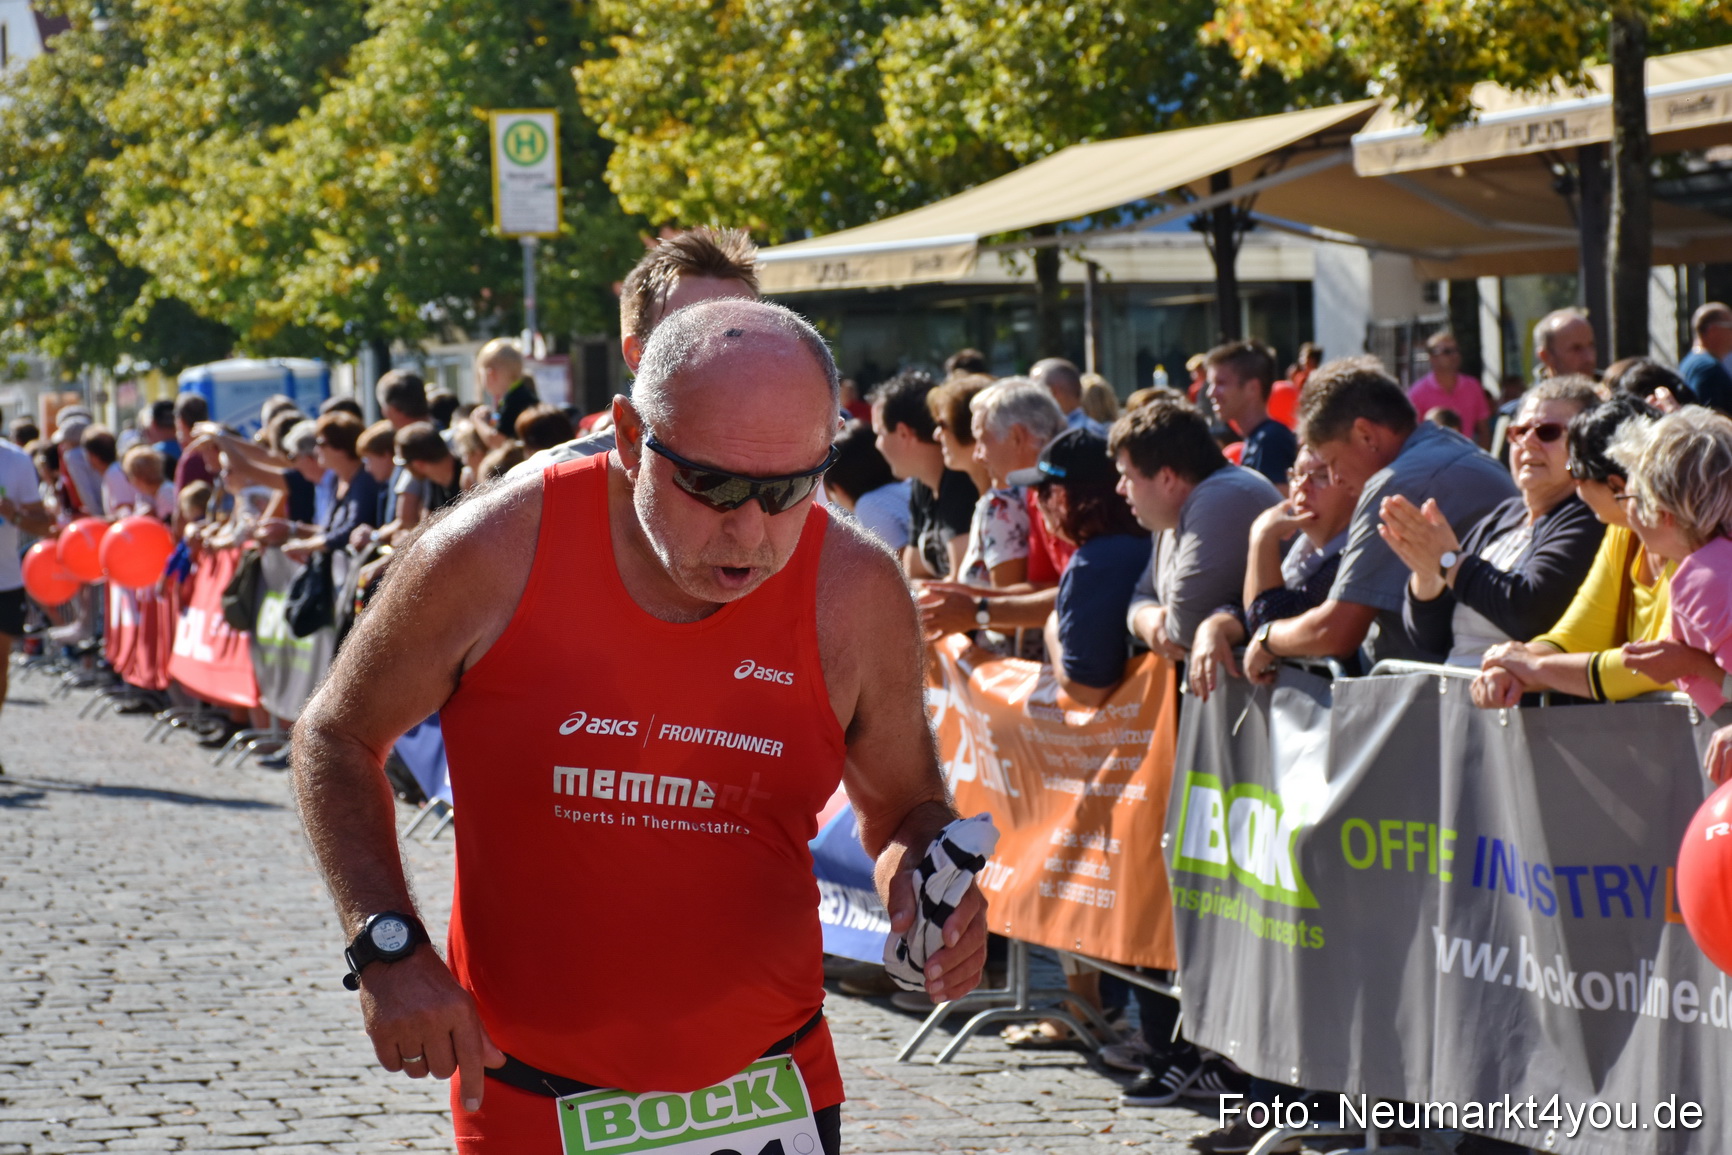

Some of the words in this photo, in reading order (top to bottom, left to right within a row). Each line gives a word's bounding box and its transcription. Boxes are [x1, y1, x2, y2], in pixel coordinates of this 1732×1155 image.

[515, 132, 536, 156] H
[658, 723, 784, 757] FRONTRUNNER
[554, 805, 614, 824] Experts
[621, 812, 636, 827] in
[642, 815, 750, 835] Thermostatics
[580, 1068, 790, 1149] BOCK
